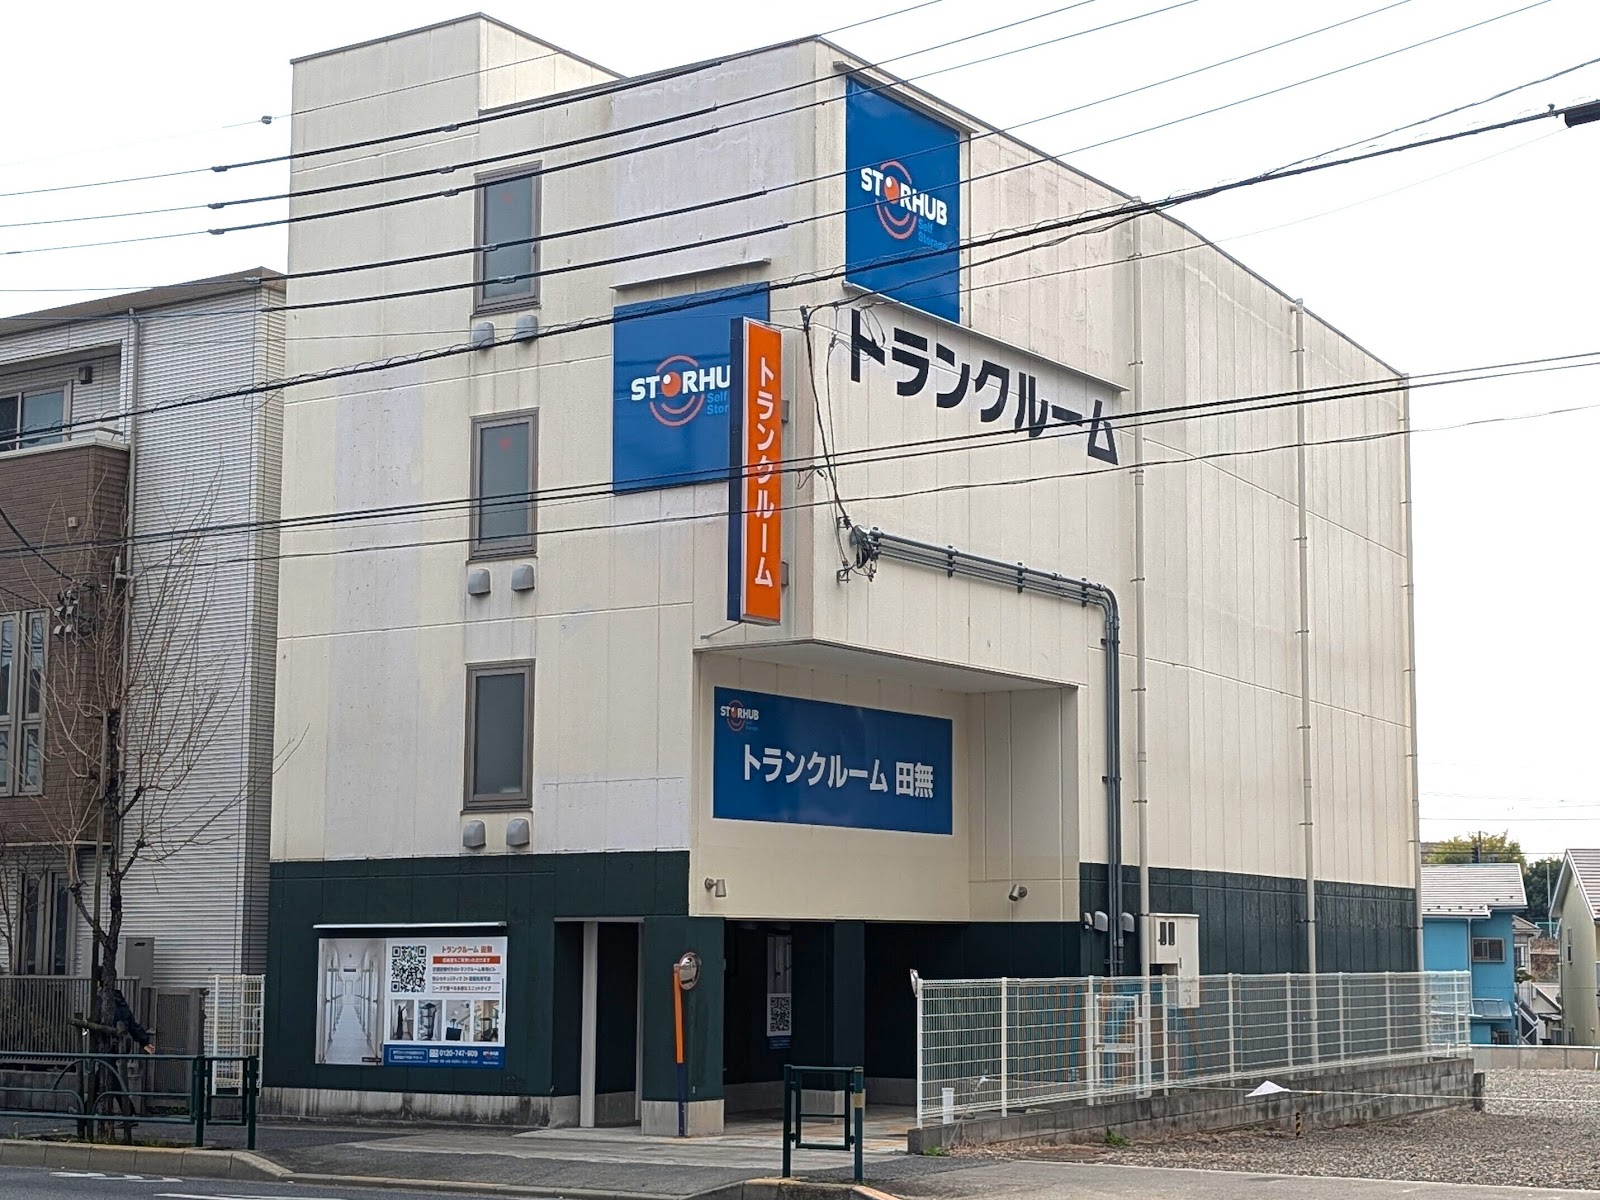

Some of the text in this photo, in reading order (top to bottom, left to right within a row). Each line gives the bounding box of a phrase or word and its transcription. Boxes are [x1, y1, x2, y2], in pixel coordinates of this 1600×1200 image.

[861, 167, 948, 226] STORHUB
[918, 218, 933, 234] Self
[631, 364, 731, 401] STORHU
[851, 308, 1119, 466] トランクルーム
[707, 391, 728, 403] Self
[707, 403, 729, 415] Stor
[754, 356, 775, 588] トランクルーム
[720, 705, 760, 721] STORHUB
[744, 743, 934, 799] トランクルーム 田無
[442, 945, 479, 953] トランクルーム
